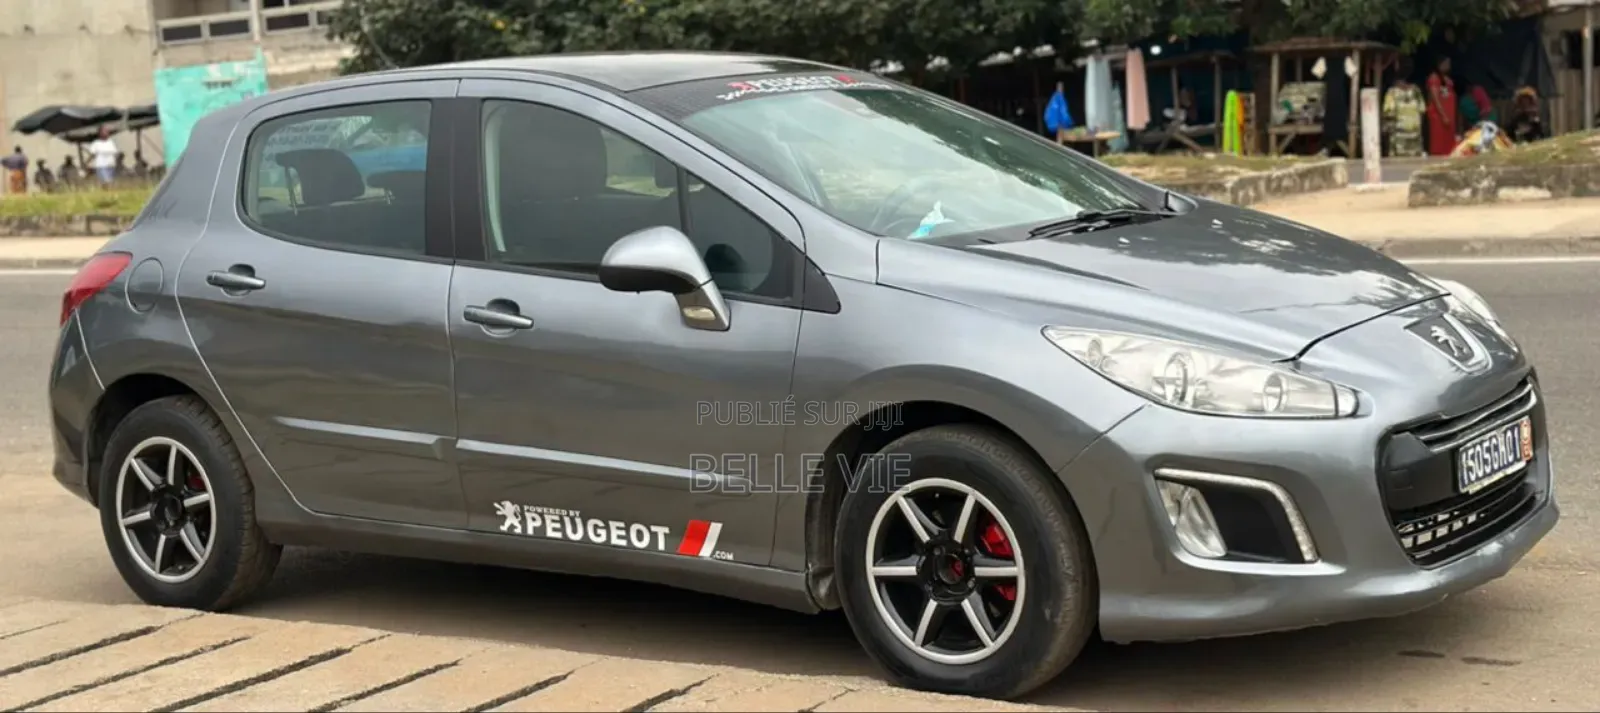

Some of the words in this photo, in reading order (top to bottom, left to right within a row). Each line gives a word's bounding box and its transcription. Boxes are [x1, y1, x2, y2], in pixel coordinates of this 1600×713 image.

[523, 505, 568, 516] POWERED
[569, 509, 581, 517] BY
[524, 511, 670, 551] PEUGEOT
